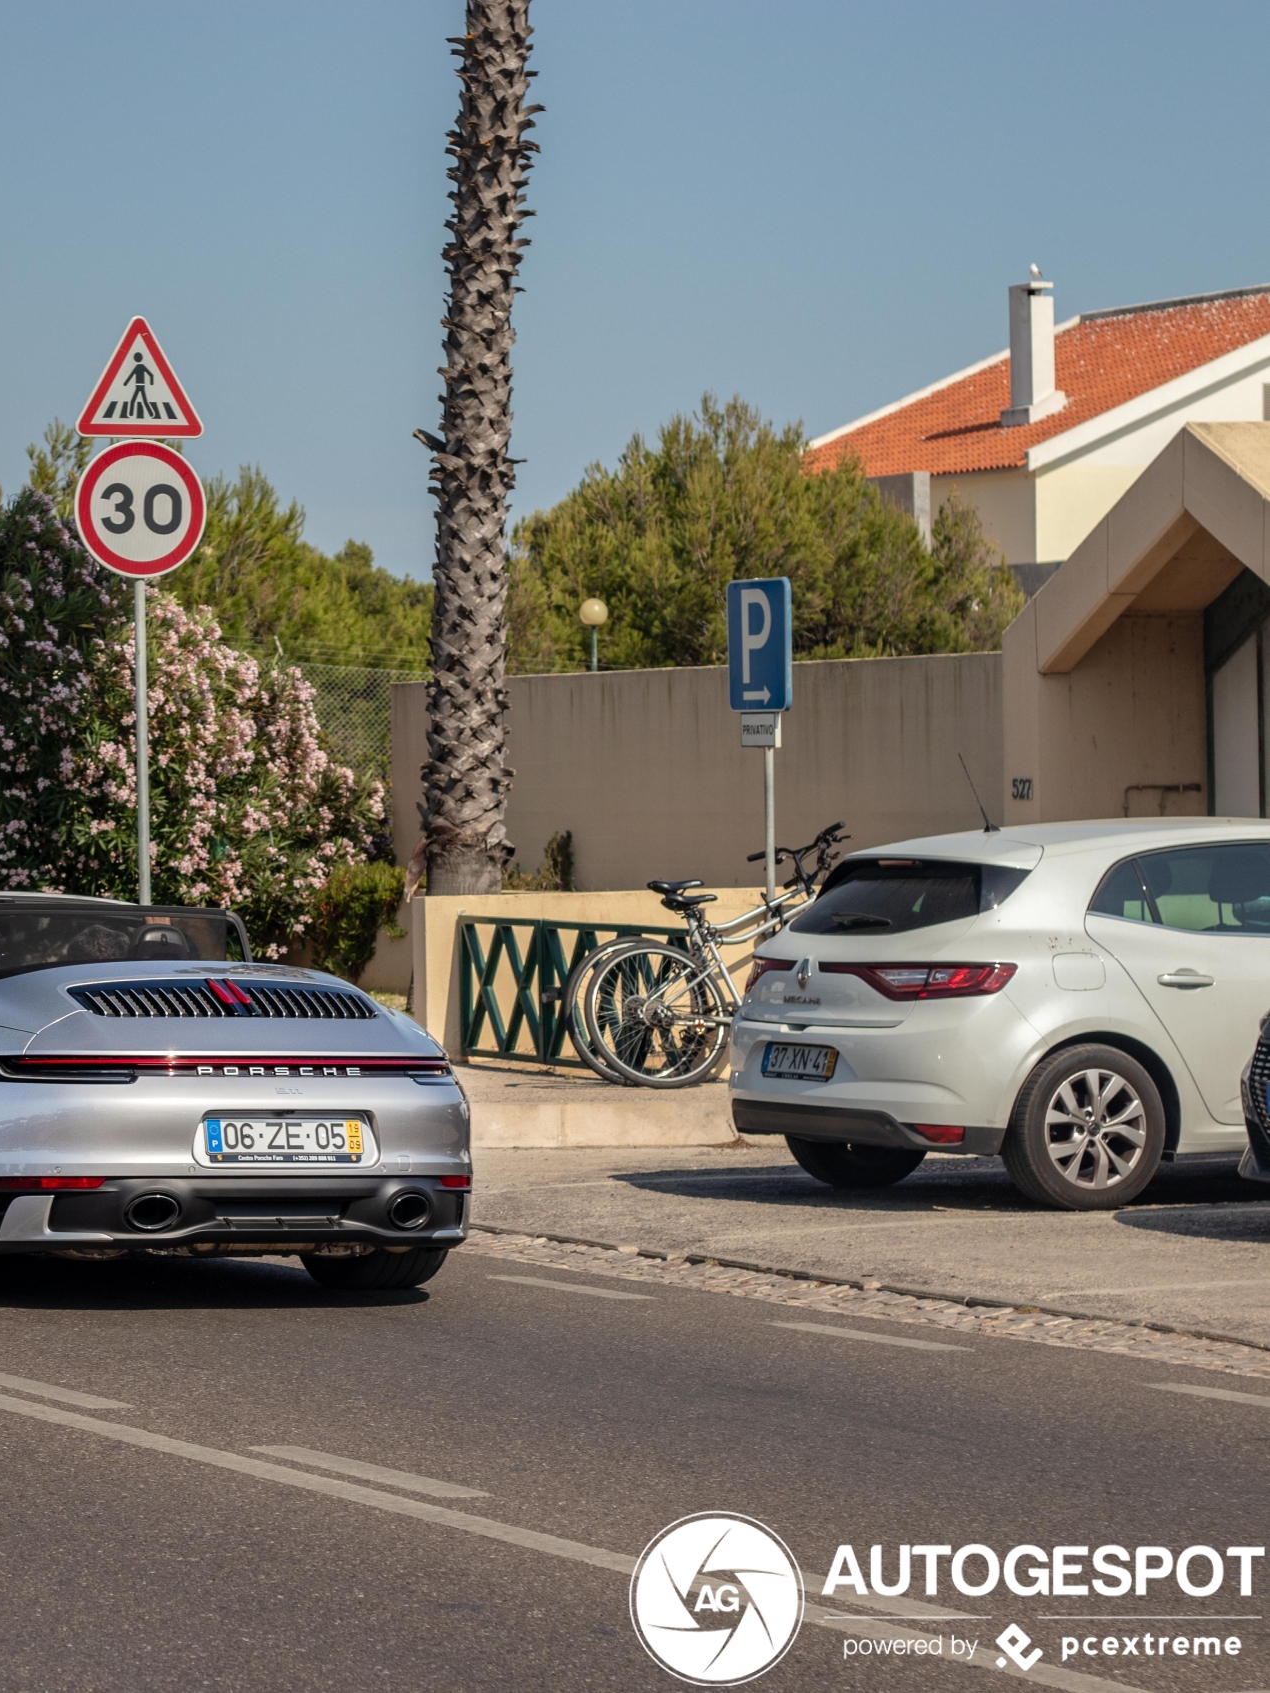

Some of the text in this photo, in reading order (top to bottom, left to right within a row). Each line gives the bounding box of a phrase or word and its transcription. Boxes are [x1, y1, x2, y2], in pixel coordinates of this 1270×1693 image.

[100, 482, 182, 535] 30
[741, 588, 771, 684] P
[742, 724, 774, 736] PRIVATIVO
[1012, 778, 1031, 799] 527
[197, 1066, 361, 1076] PORSCHE
[349, 1123, 359, 1133] 19
[349, 1140, 361, 1150] 09
